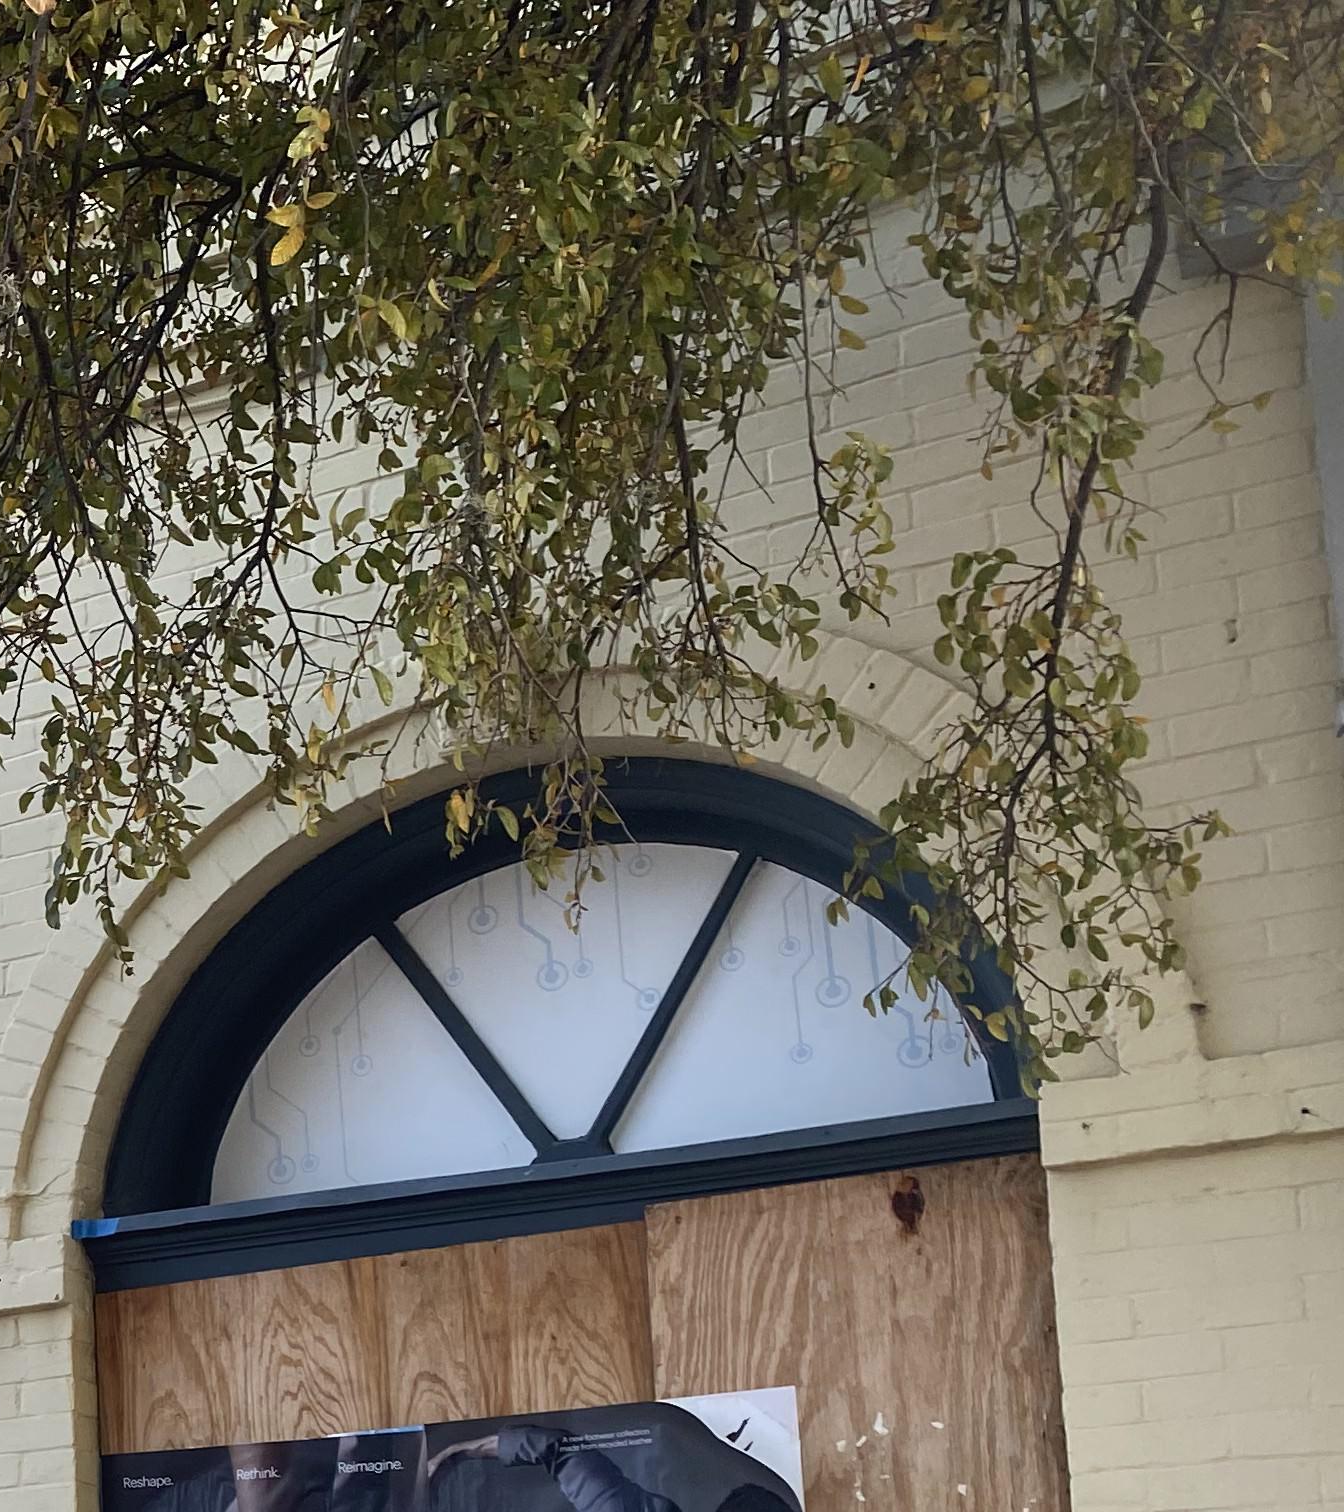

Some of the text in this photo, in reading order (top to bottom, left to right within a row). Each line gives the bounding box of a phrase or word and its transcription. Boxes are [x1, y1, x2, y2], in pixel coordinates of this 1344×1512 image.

[123, 1458, 405, 1489] Reshape. Rethink. Reimagine.
